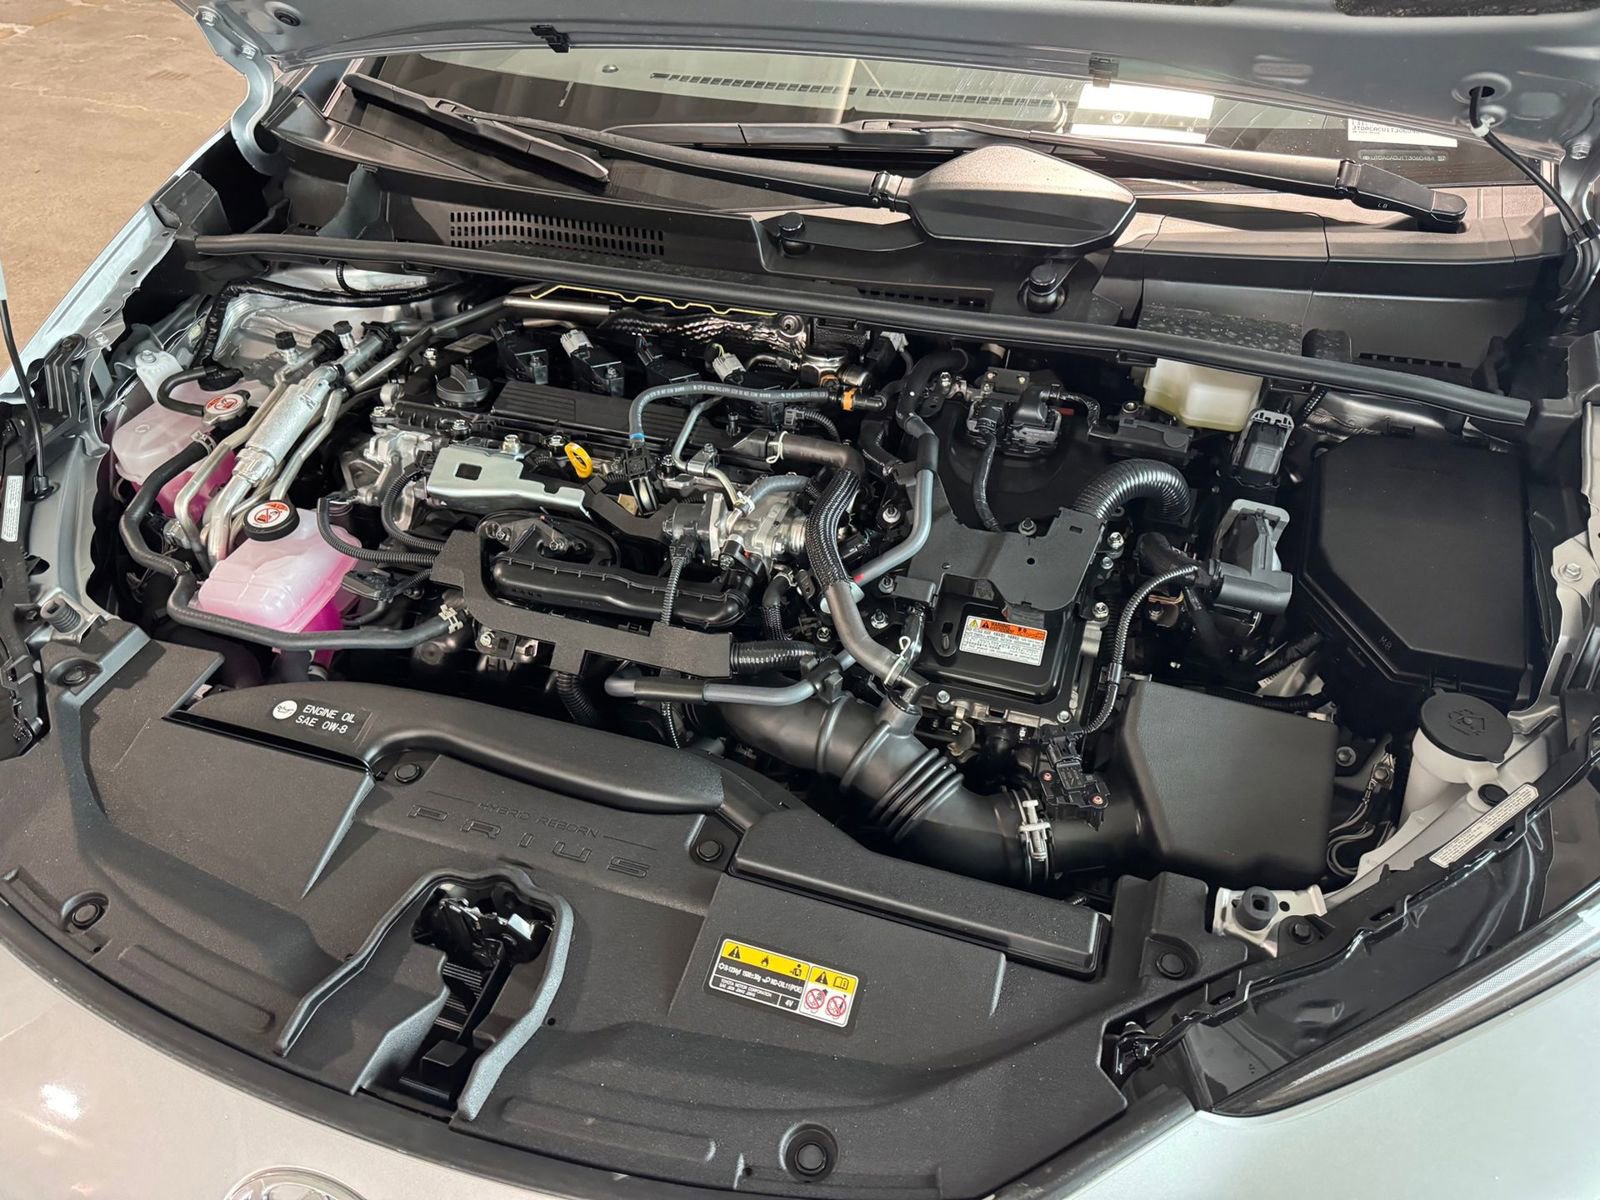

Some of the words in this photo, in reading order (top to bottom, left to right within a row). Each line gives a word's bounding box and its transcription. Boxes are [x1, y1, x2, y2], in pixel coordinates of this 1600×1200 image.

[295, 715, 319, 727] SAE
[321, 720, 348, 734] 0W-8
[303, 704, 339, 719] ENGINE
[341, 712, 355, 724] OIL
[535, 816, 601, 839] REBORN
[407, 804, 650, 878] PRIUS
